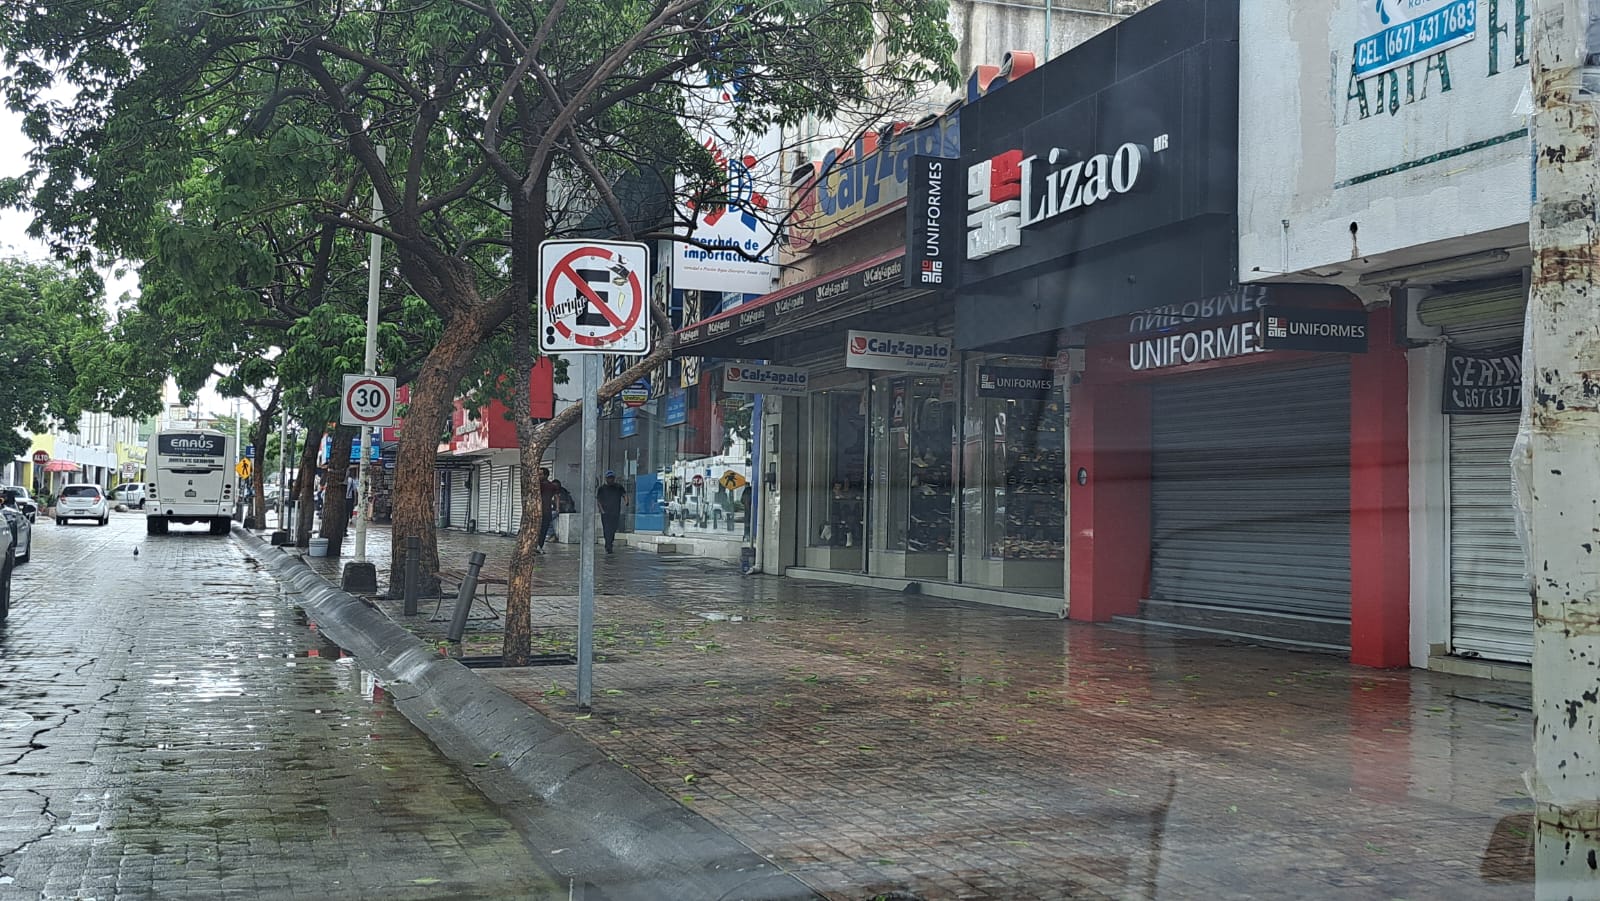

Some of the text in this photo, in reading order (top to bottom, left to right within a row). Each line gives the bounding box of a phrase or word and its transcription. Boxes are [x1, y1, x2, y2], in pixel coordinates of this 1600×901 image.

[1358, 0, 1475, 67] CEL. (667) 431 7683
[1018, 133, 1169, 229] Lizao MR
[926, 162, 942, 256] UNIFORMES
[684, 245, 770, 263] importacioes
[744, 239, 759, 251] de
[575, 268, 610, 326] E
[1289, 322, 1365, 338] UNIFORMES
[996, 376, 1052, 391] UNIFORMES
[356, 388, 381, 408] 30
[34, 453, 49, 462] ALTO
